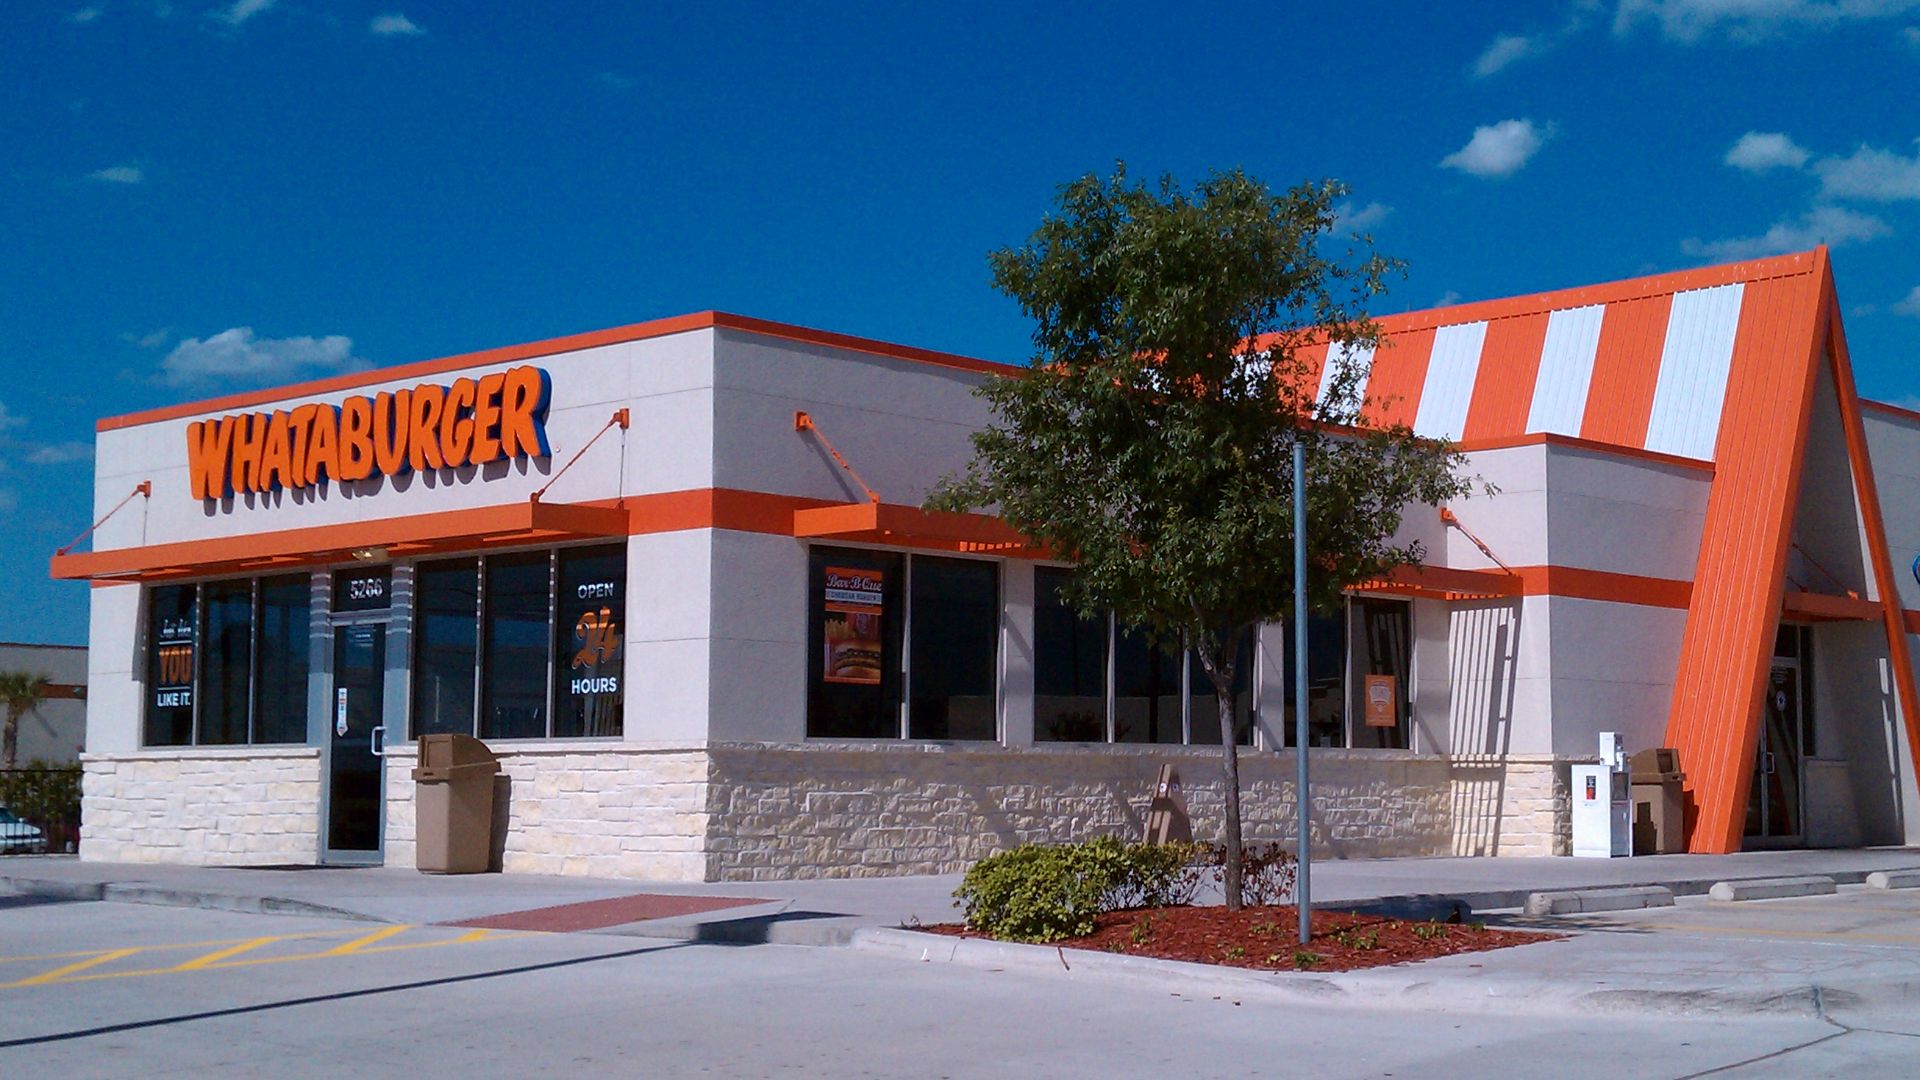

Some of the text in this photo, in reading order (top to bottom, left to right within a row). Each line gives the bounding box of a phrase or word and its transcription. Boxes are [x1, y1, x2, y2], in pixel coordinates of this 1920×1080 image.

[186, 365, 548, 501] WHATABURGER
[350, 578, 383, 600] 5266
[577, 582, 614, 599] OPEN
[571, 604, 620, 670] 24
[158, 645, 193, 684] YOU
[571, 677, 617, 694] HOURS
[157, 692, 179, 707] LIKE
